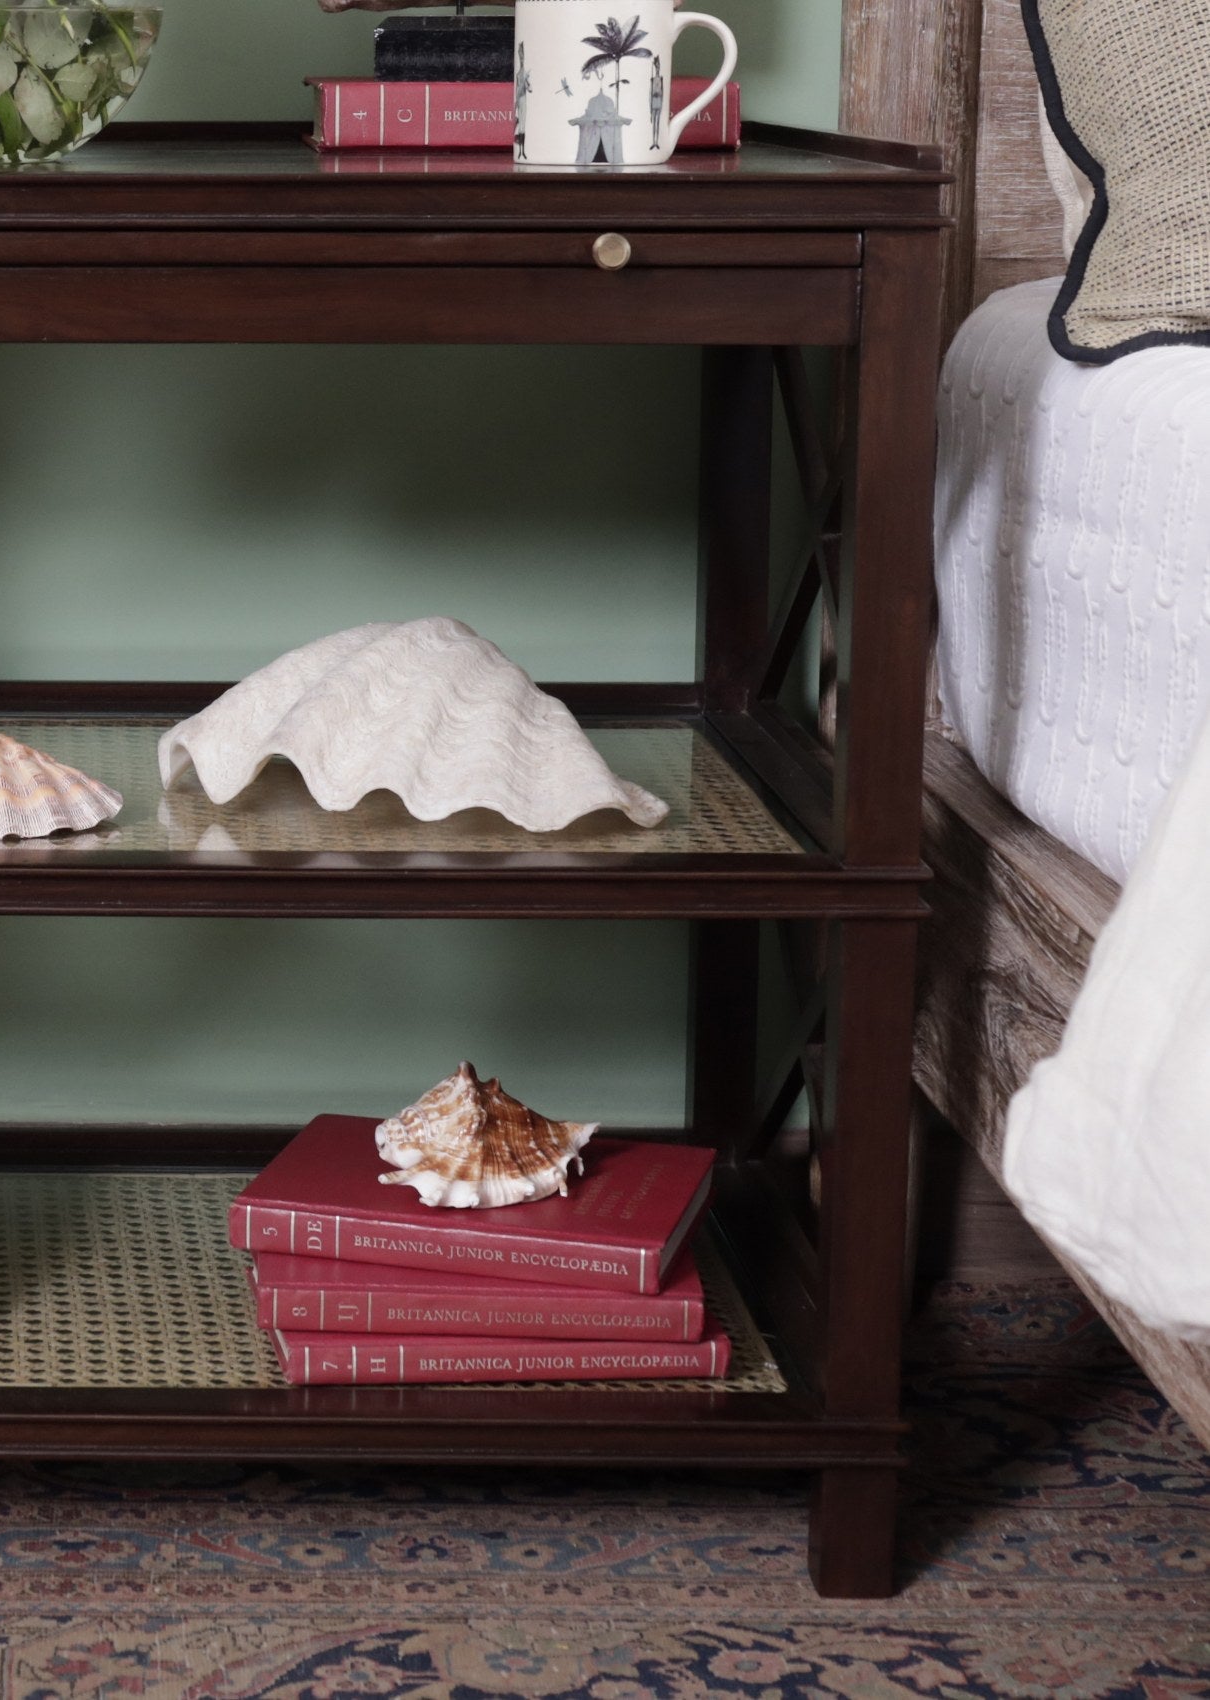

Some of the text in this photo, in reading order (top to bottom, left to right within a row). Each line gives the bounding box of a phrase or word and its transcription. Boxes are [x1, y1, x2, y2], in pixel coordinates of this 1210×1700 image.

[352, 110, 368, 121] 4
[397, 109, 413, 123] C
[444, 110, 513, 121] BRITANNI
[263, 1227, 278, 1236] 5
[306, 1220, 324, 1251] DE
[354, 1235, 629, 1275] BRITANNICA JUNIOR ENCYCLOPÆDIA
[292, 1306, 308, 1317] 8
[387, 1308, 672, 1328] BRITANNICA JUNIOR ENCYCLOPÆDIA
[322, 1361, 339, 1371] 7
[370, 1358, 386, 1373] H
[419, 1355, 700, 1373] BRITANNICA JUNIOR ENCYCLOPÆDIA
